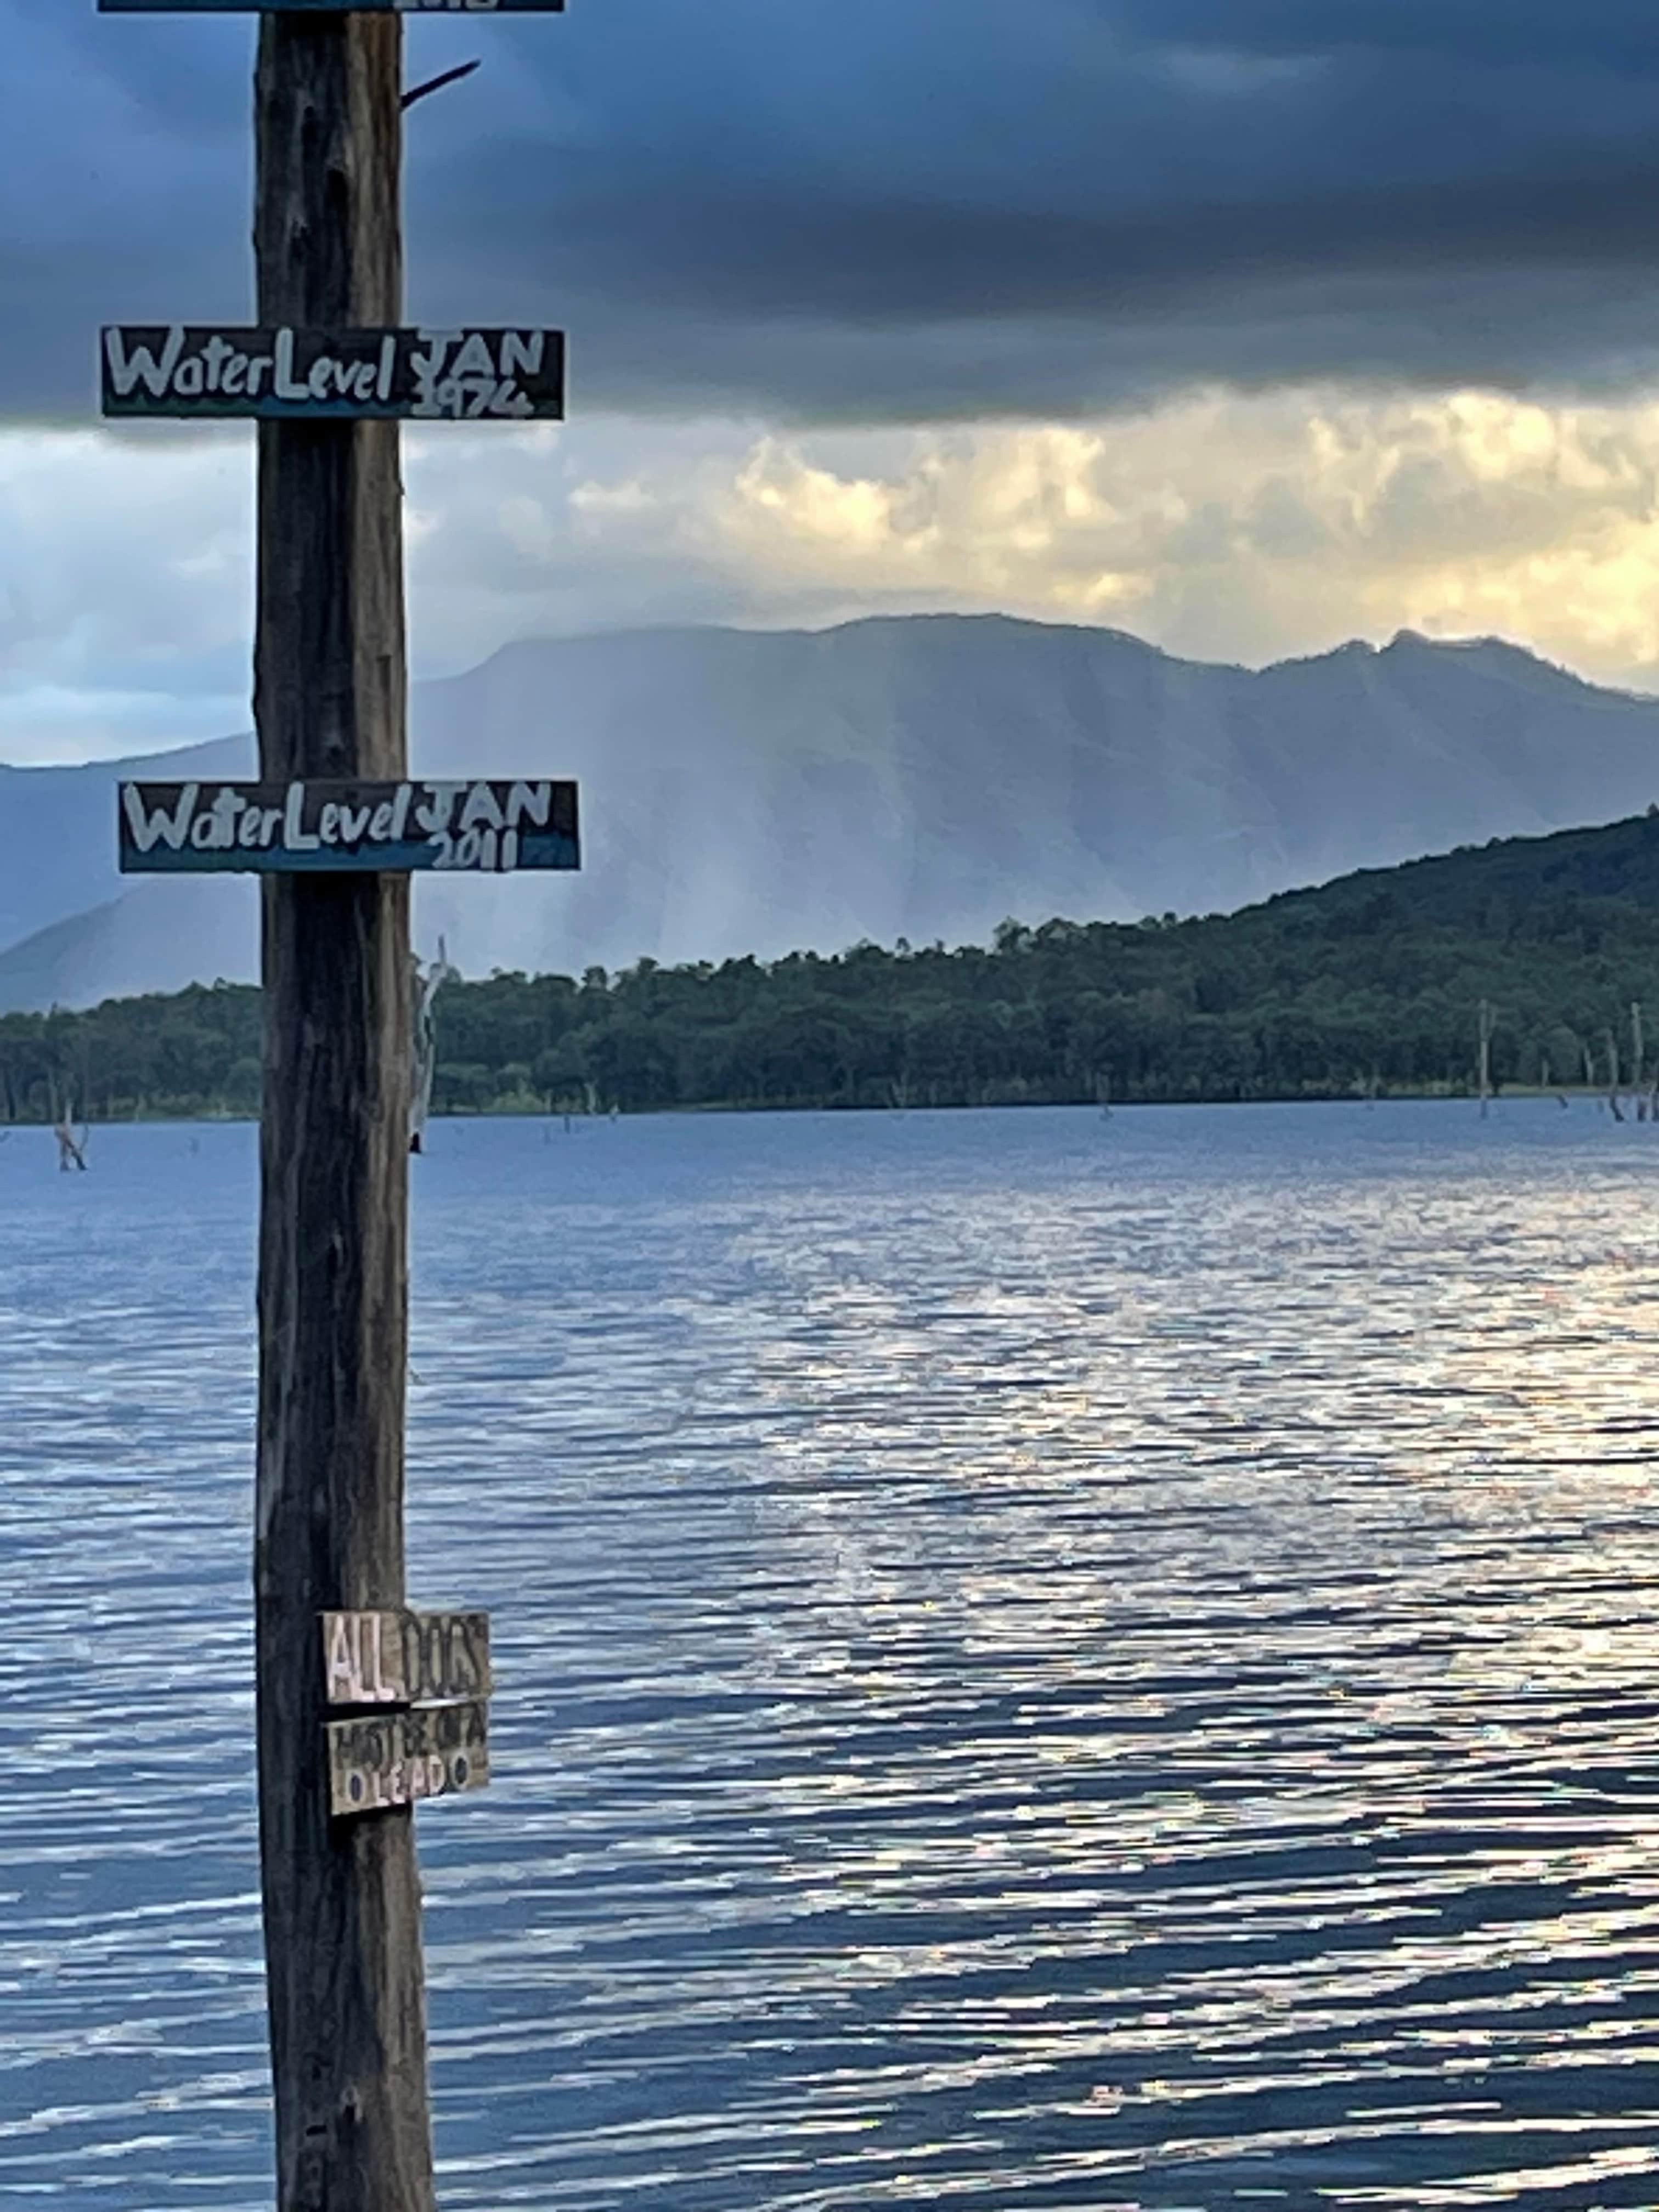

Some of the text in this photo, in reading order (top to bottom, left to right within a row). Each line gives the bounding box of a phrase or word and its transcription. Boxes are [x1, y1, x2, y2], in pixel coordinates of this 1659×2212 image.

[107, 328, 545, 400] Water Level JAN
[123, 782, 549, 852] Water Level JAN
[431, 828, 517, 869] 2011
[329, 1615, 396, 1701] ALL
